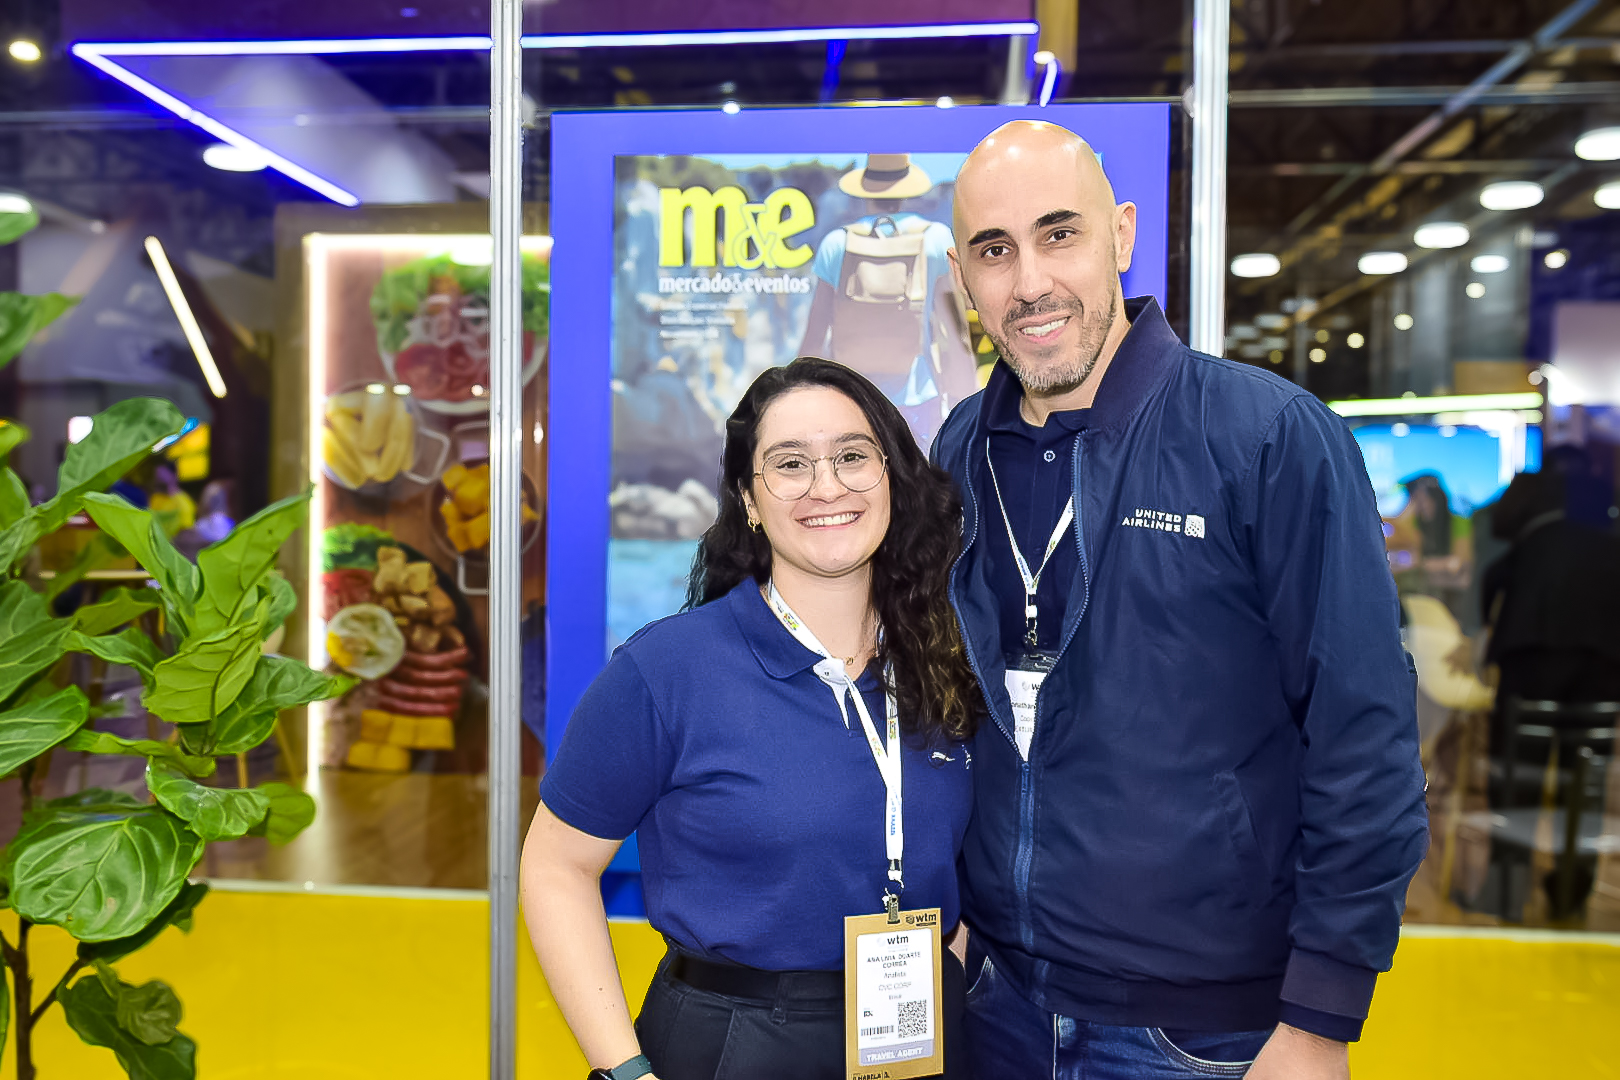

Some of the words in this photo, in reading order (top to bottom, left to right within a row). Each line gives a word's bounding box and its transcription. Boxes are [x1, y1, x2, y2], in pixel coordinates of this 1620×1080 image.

[659, 186, 815, 269] m&e
[659, 272, 810, 293] mercado&eventos
[1135, 508, 1182, 523] UNITED
[1121, 516, 1181, 533] AIRLINES
[915, 912, 937, 923] wtm
[887, 934, 909, 945] wtm
[866, 1050, 896, 1062] TRAVEL
[897, 1046, 923, 1057] AGENT
